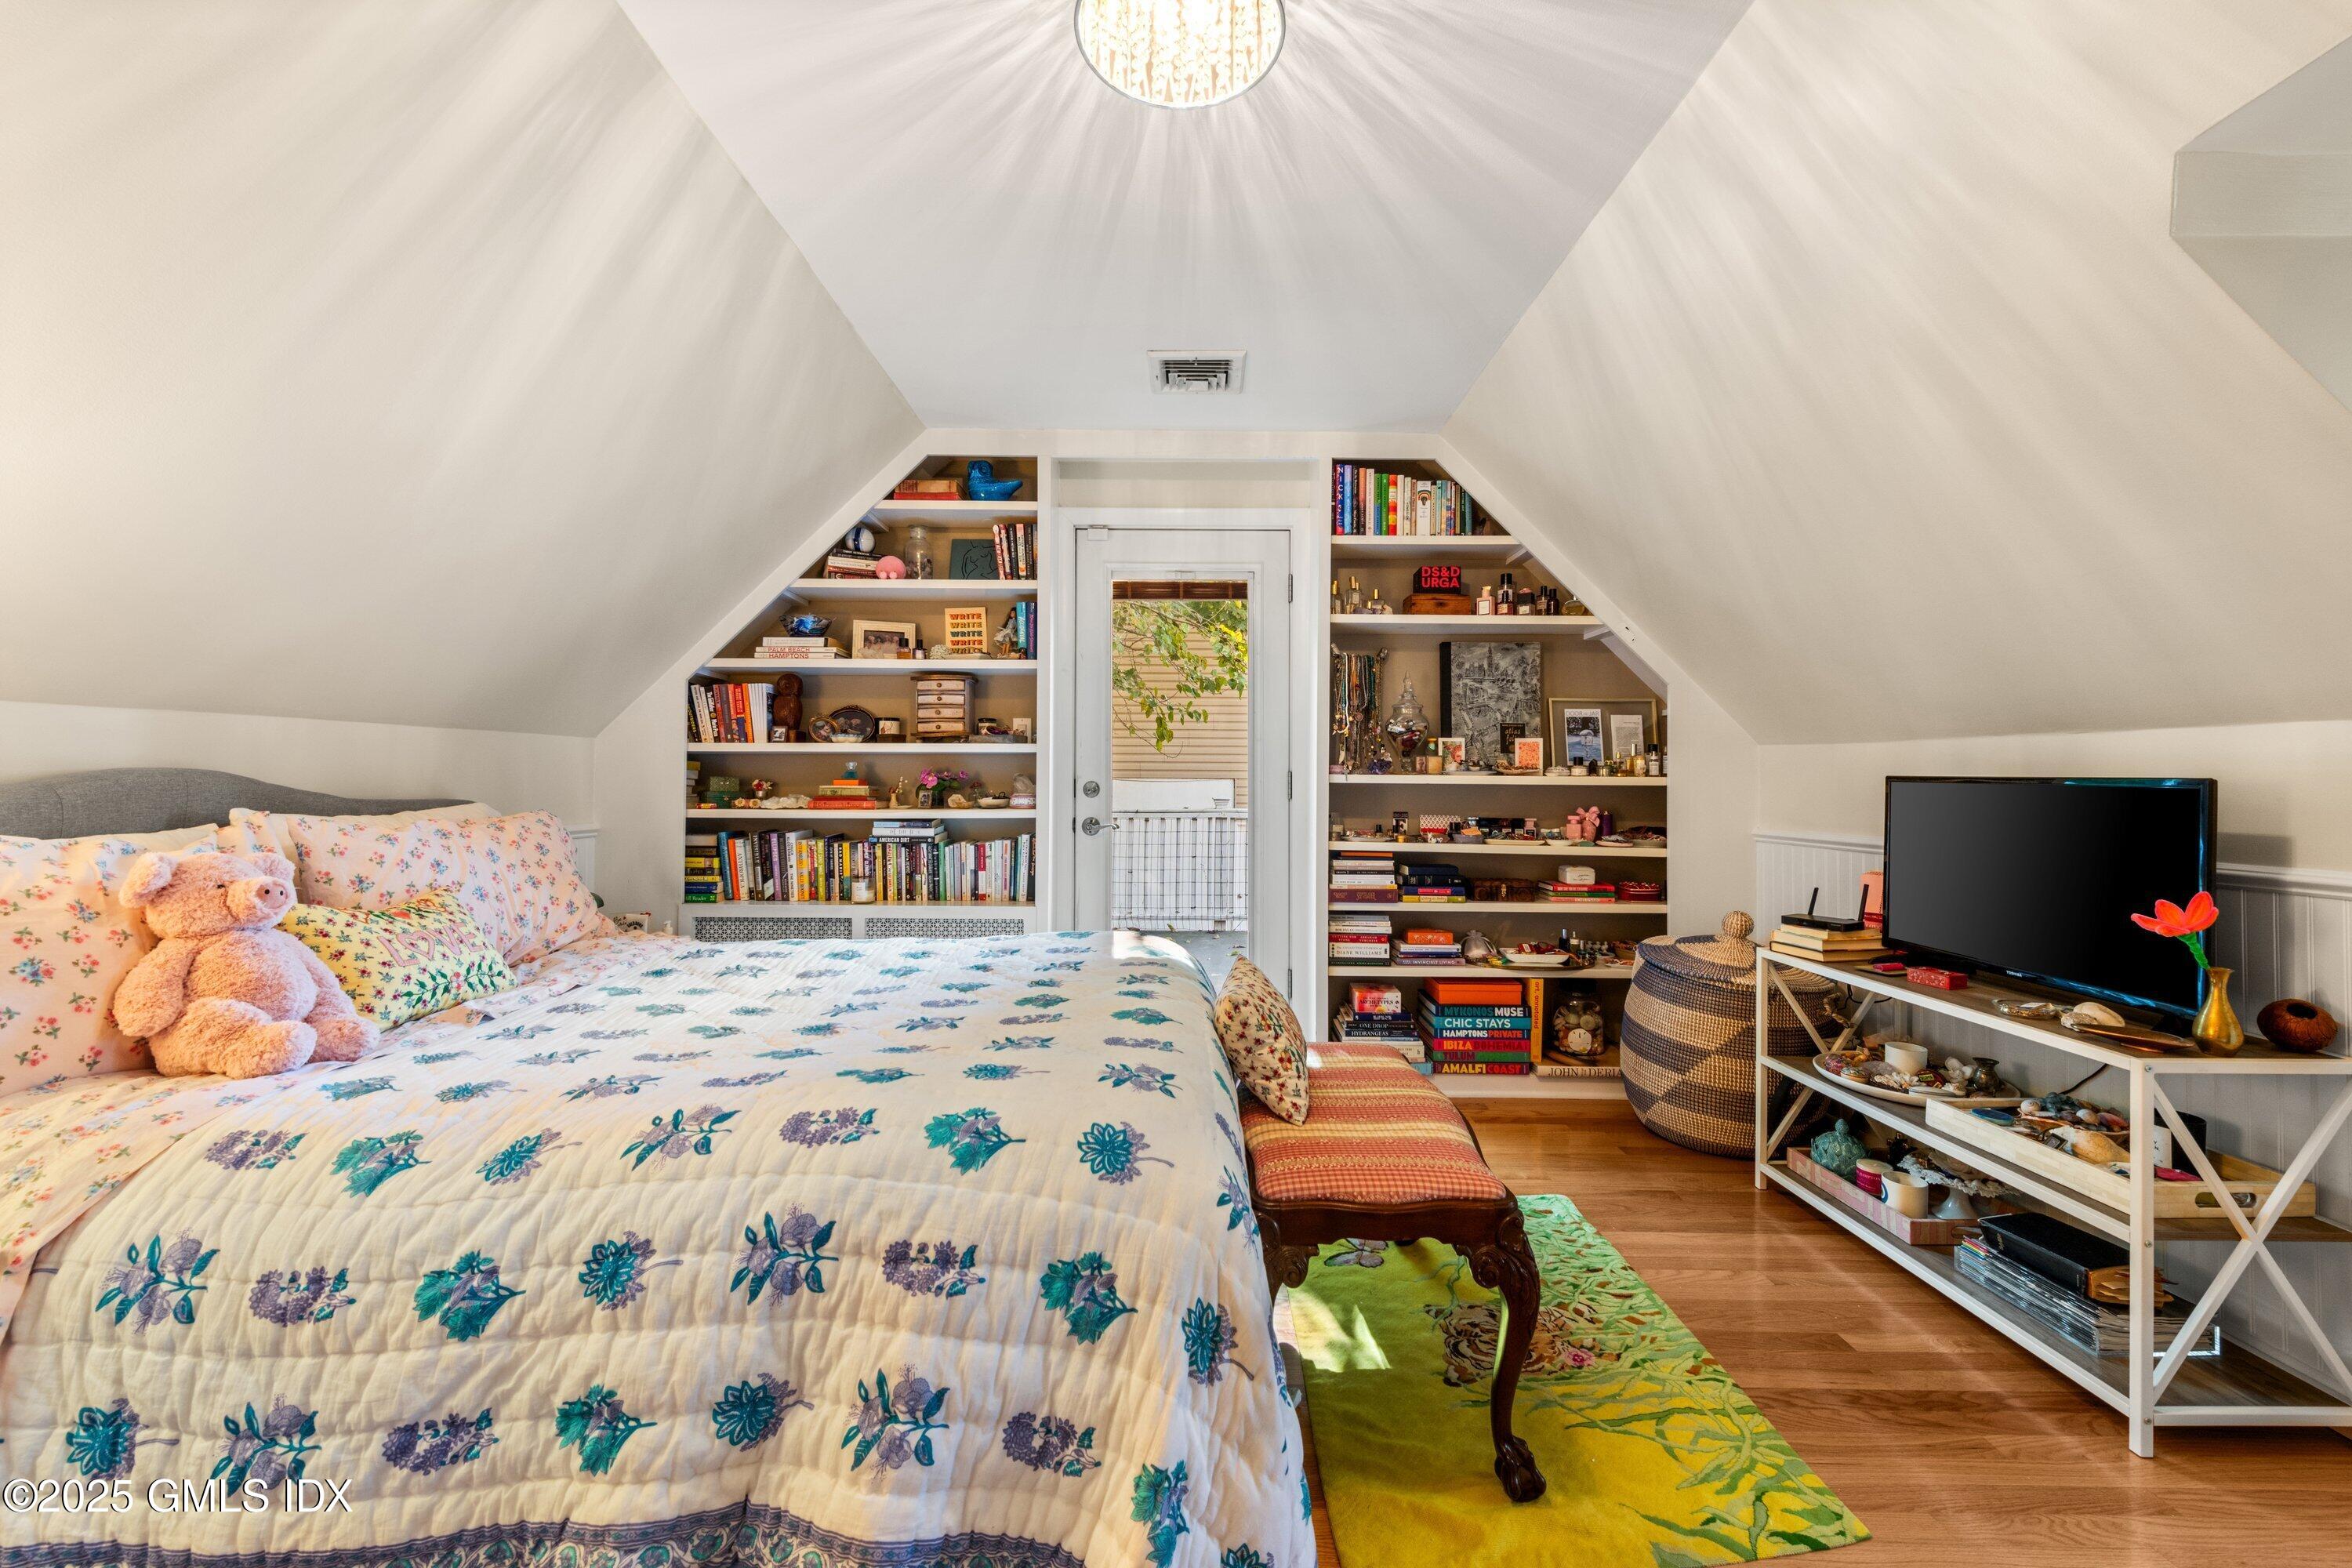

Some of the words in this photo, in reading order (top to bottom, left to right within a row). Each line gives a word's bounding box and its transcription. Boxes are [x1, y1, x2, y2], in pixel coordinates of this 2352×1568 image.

[1421, 566, 1460, 577] DS&D
[1421, 577, 1460, 588] URGA
[1444, 1007, 1494, 1017] MYKONOS
[1494, 1007, 1524, 1017] MUSE
[1444, 1018, 1472, 1028] CHIC
[1475, 1018, 1511, 1028] STAYS
[1443, 1029, 1488, 1038] HAMPTONS
[1443, 1040, 1472, 1050] IBIZA
[1442, 1063, 1486, 1073] AMALFI
[1486, 1064, 1521, 1073] COAST
[1548, 1067, 1578, 1077] JOHN
[1587, 1068, 1623, 1077] DERIA
